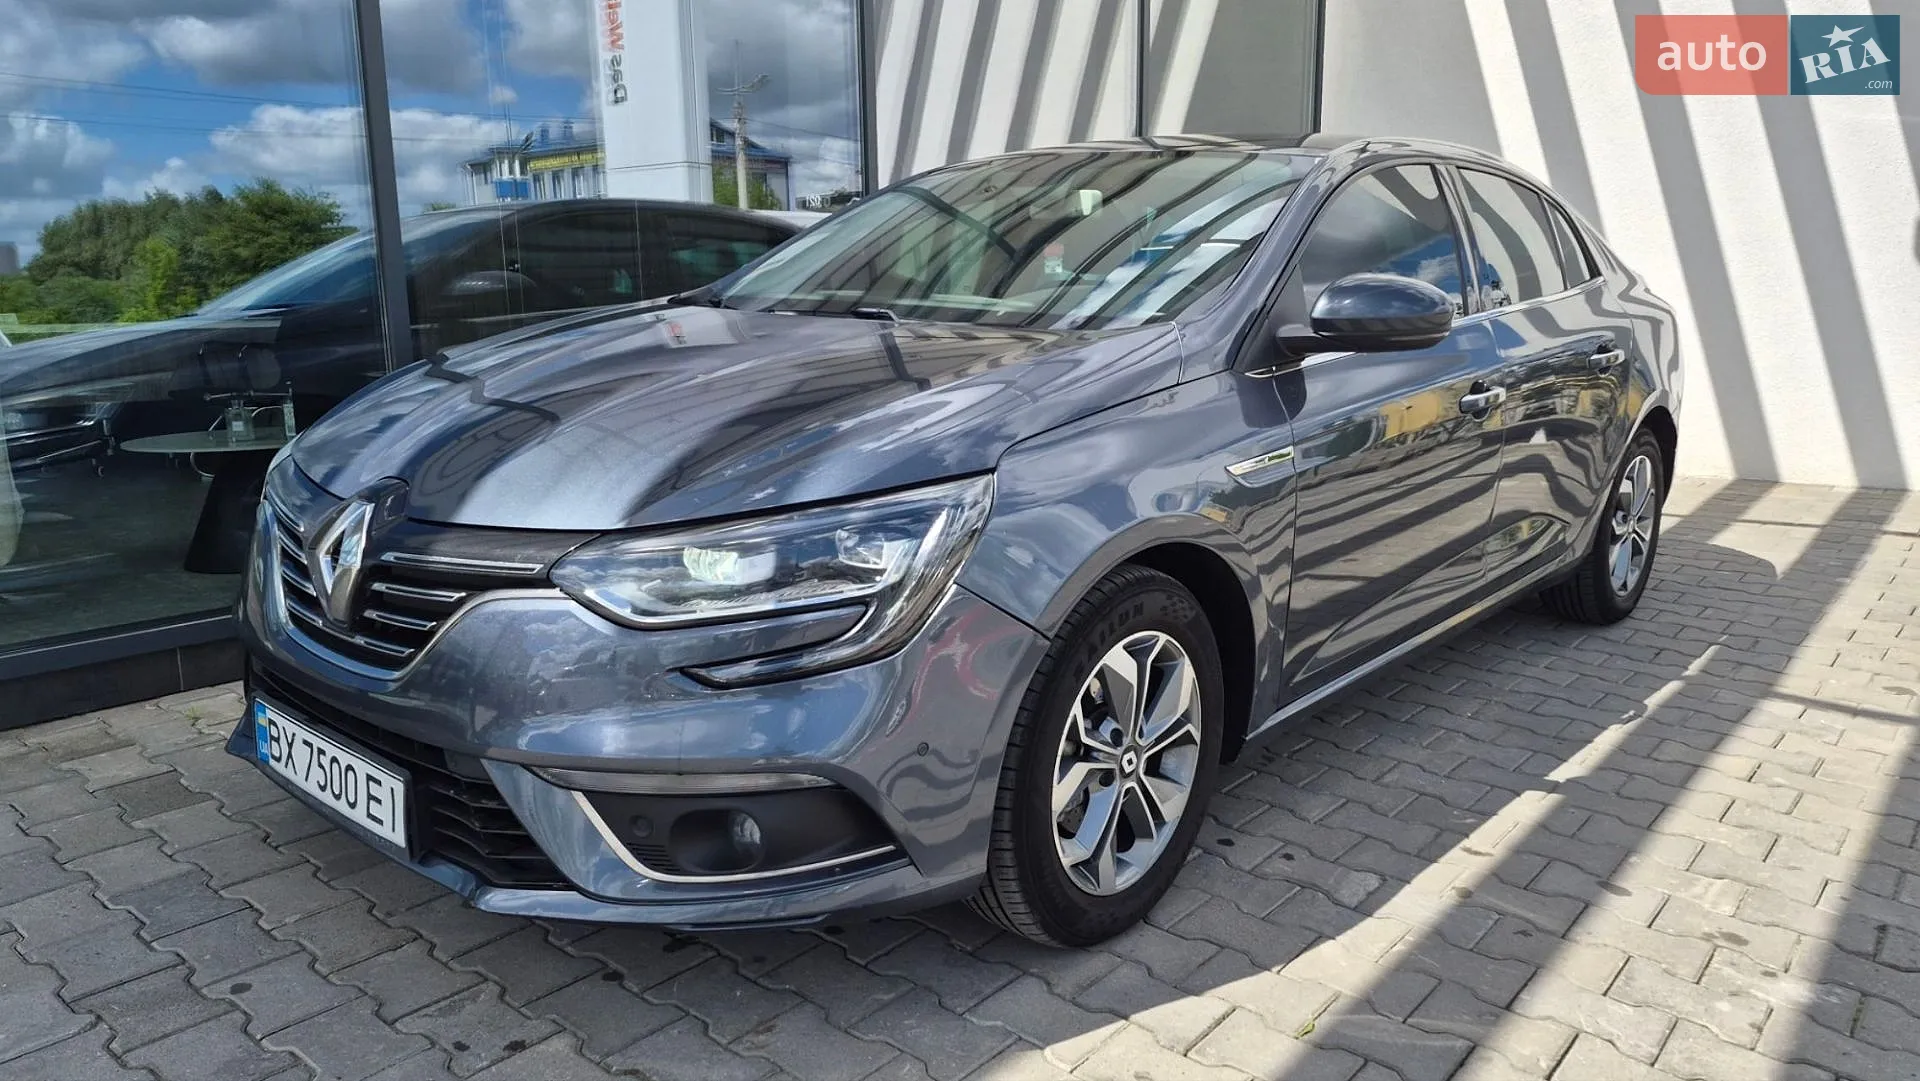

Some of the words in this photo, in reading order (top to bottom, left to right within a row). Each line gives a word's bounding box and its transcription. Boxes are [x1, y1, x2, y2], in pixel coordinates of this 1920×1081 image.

[267, 717, 298, 776] BX
[302, 737, 358, 810] 7500
[365, 772, 396, 833] EI
